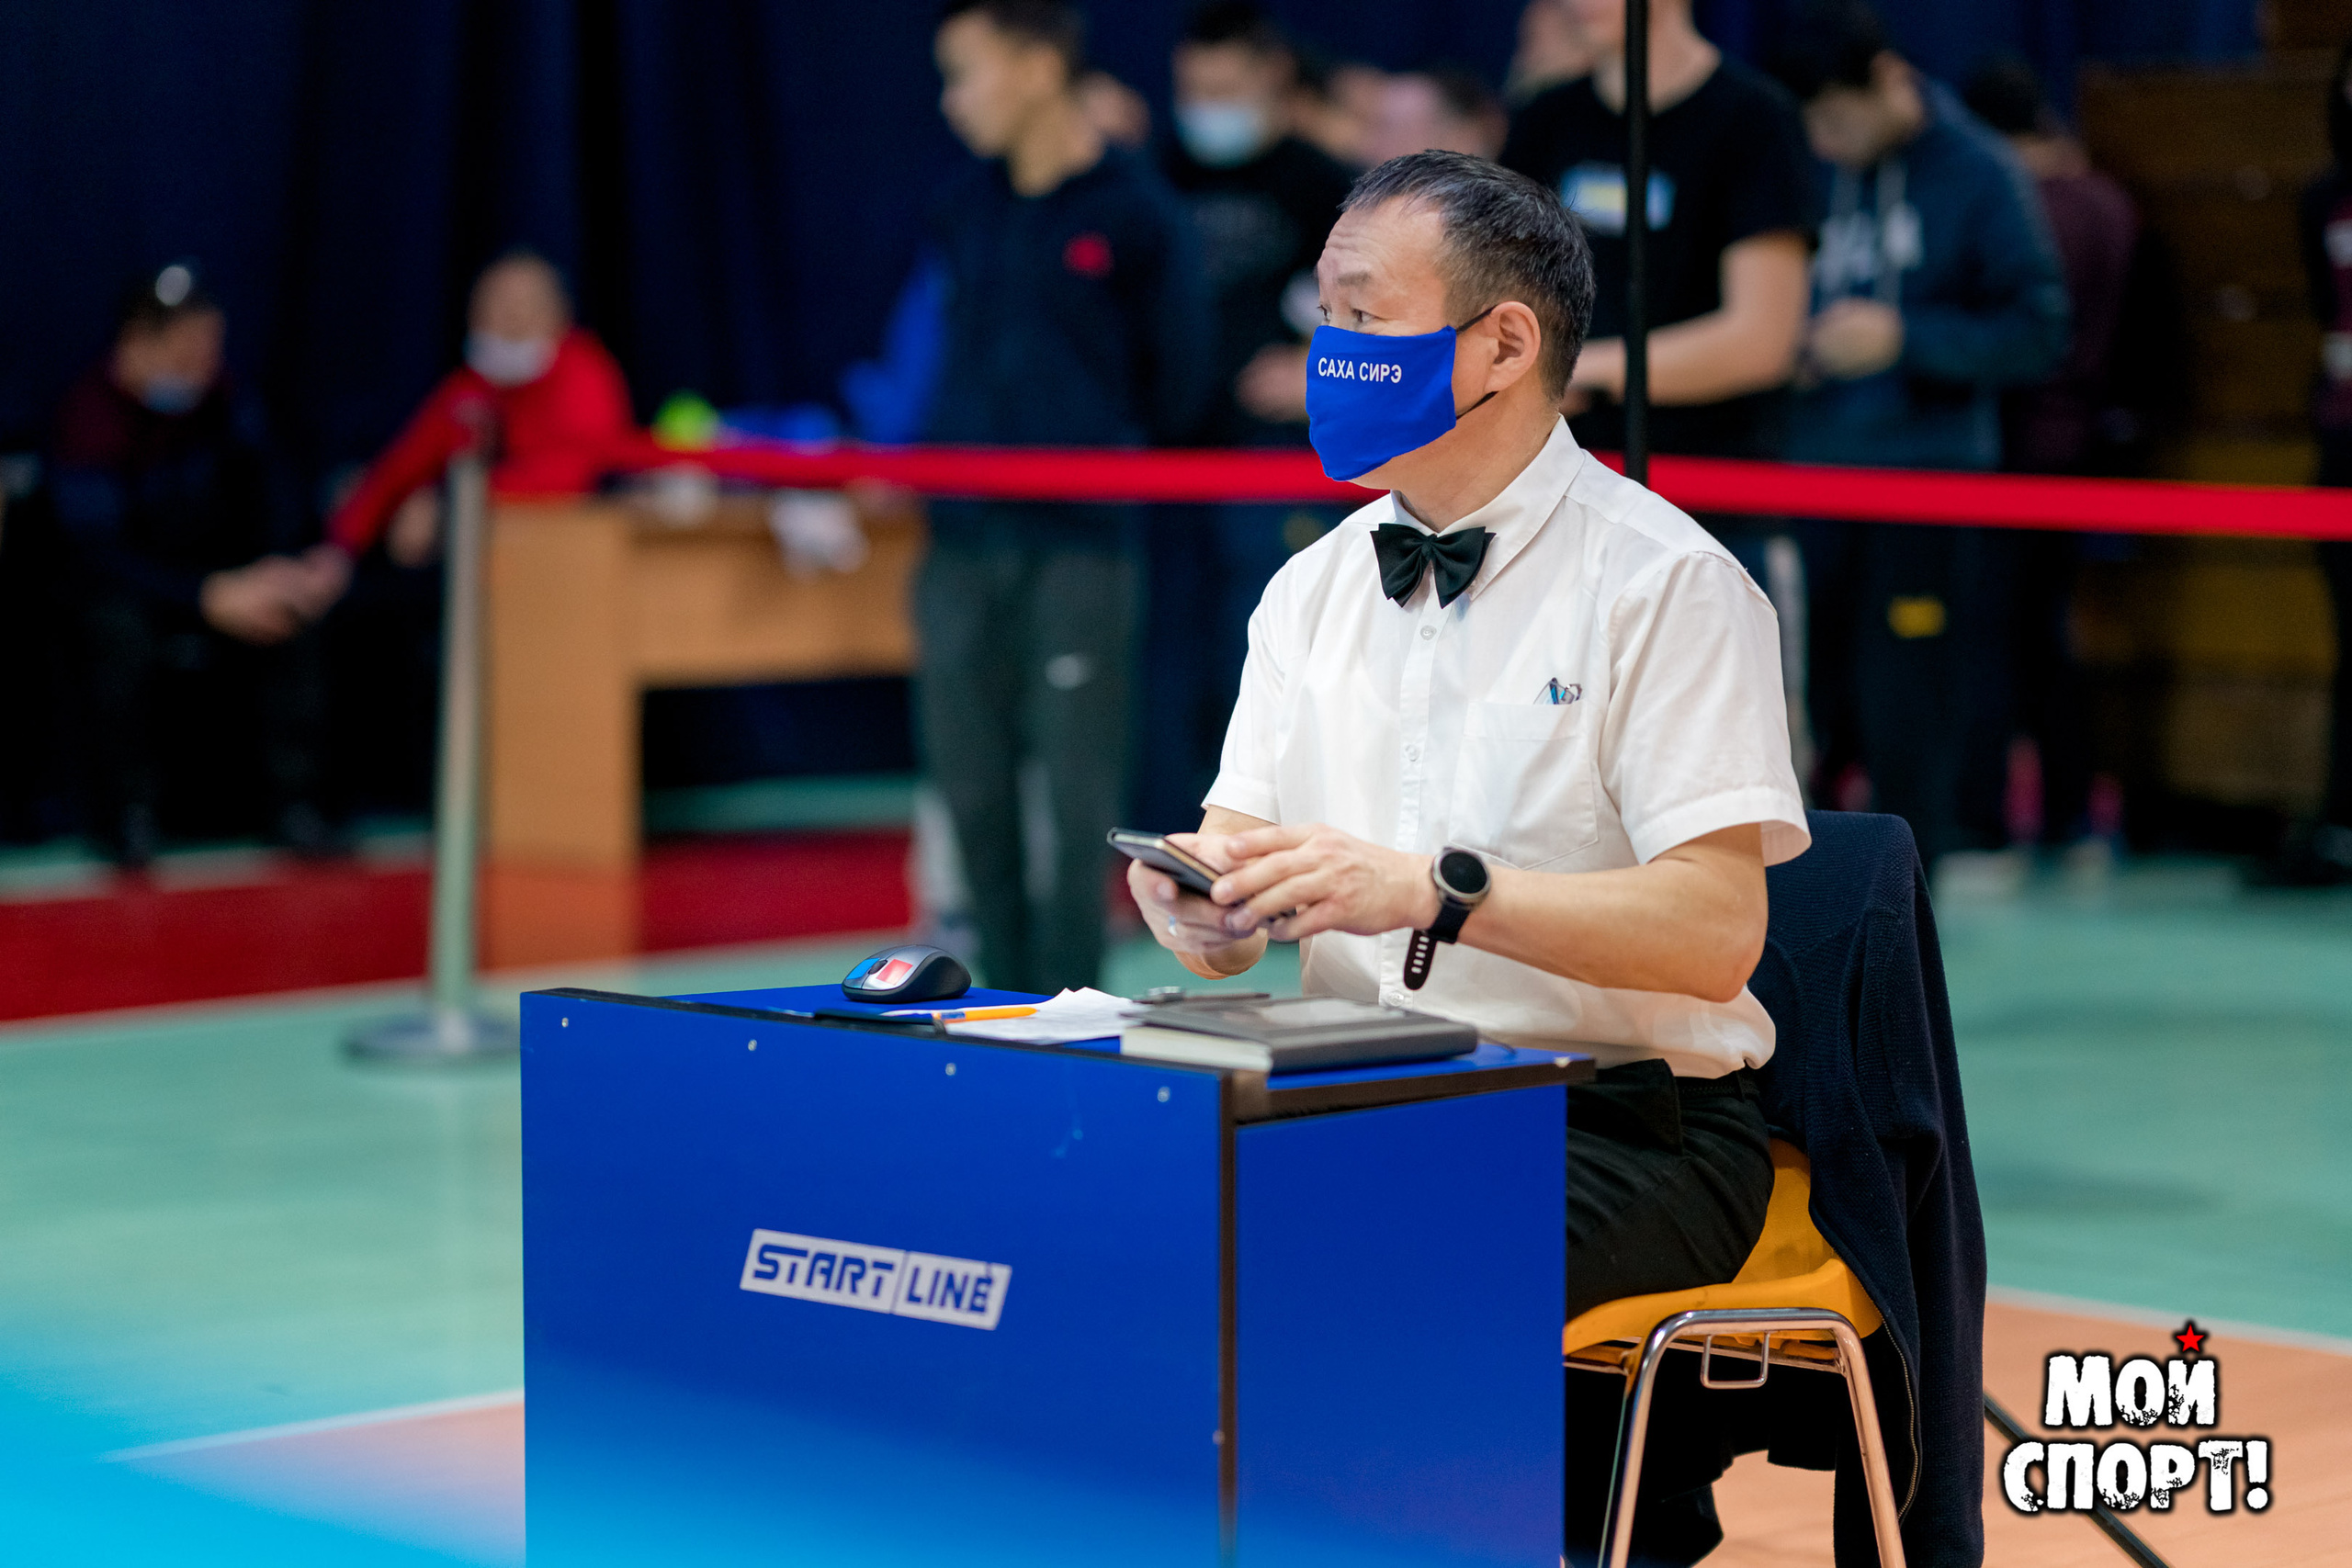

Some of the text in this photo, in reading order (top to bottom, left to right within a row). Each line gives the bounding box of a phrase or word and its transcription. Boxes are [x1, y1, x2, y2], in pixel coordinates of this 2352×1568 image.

[1317, 357, 1402, 384] САХА СИРЭ
[752, 1243, 994, 1314] START LINE
